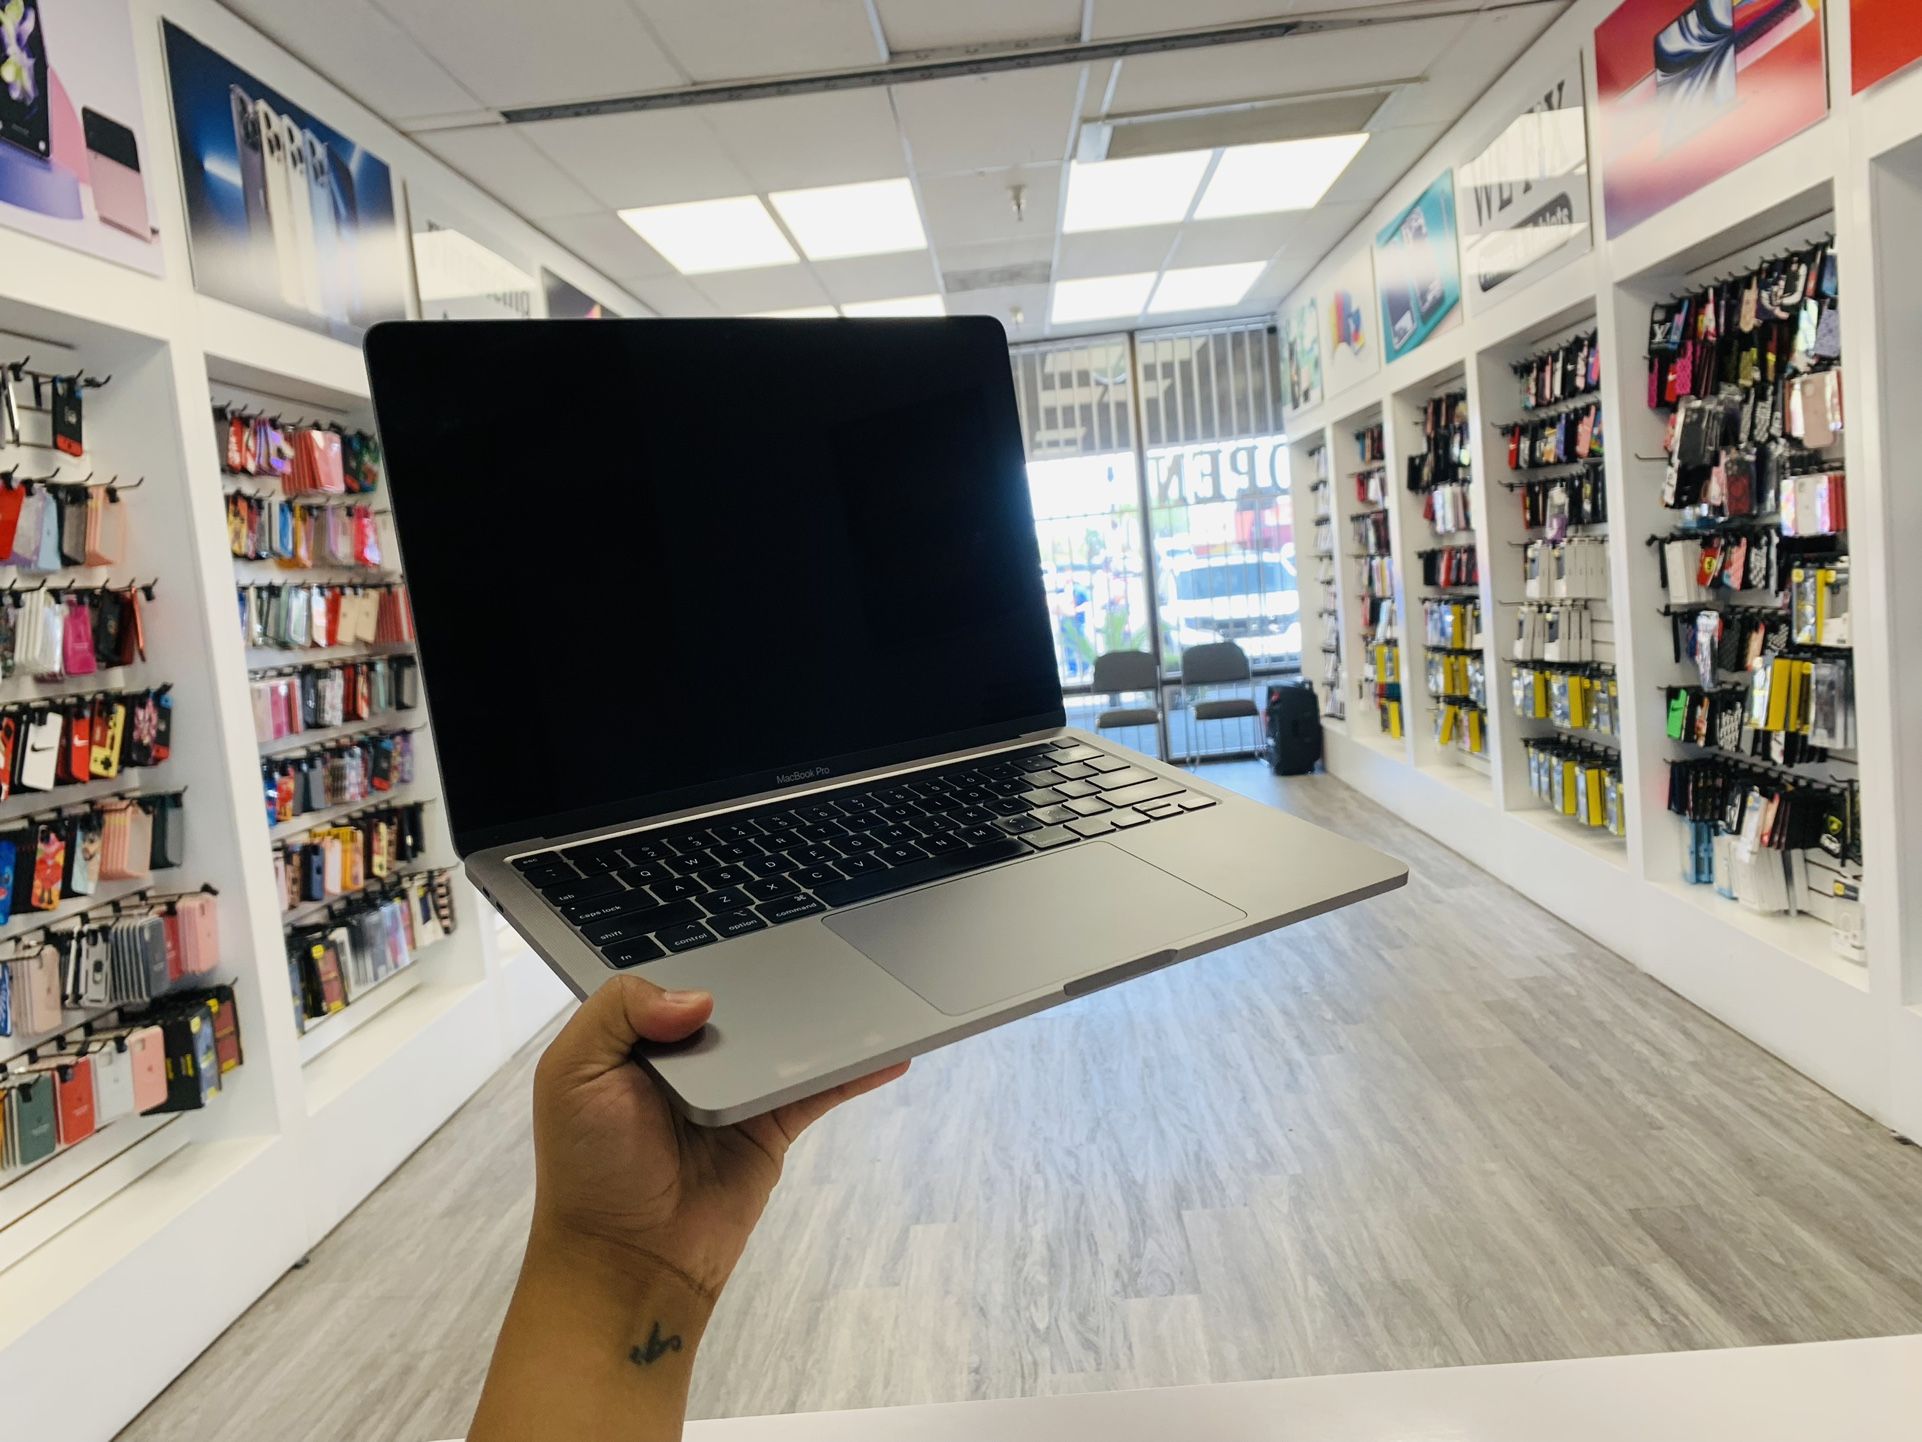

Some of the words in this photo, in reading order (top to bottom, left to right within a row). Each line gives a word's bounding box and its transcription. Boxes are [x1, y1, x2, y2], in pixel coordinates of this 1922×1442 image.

[776, 769, 815, 784] MacBook
[816, 767, 830, 776] Pro
[559, 893, 575, 901] tab
[684, 858, 698, 866] W
[579, 910, 601, 919] caps
[602, 905, 622, 915] lock
[674, 933, 708, 946] control
[728, 919, 758, 931] option
[776, 902, 817, 918] command
[600, 930, 622, 940] shift
